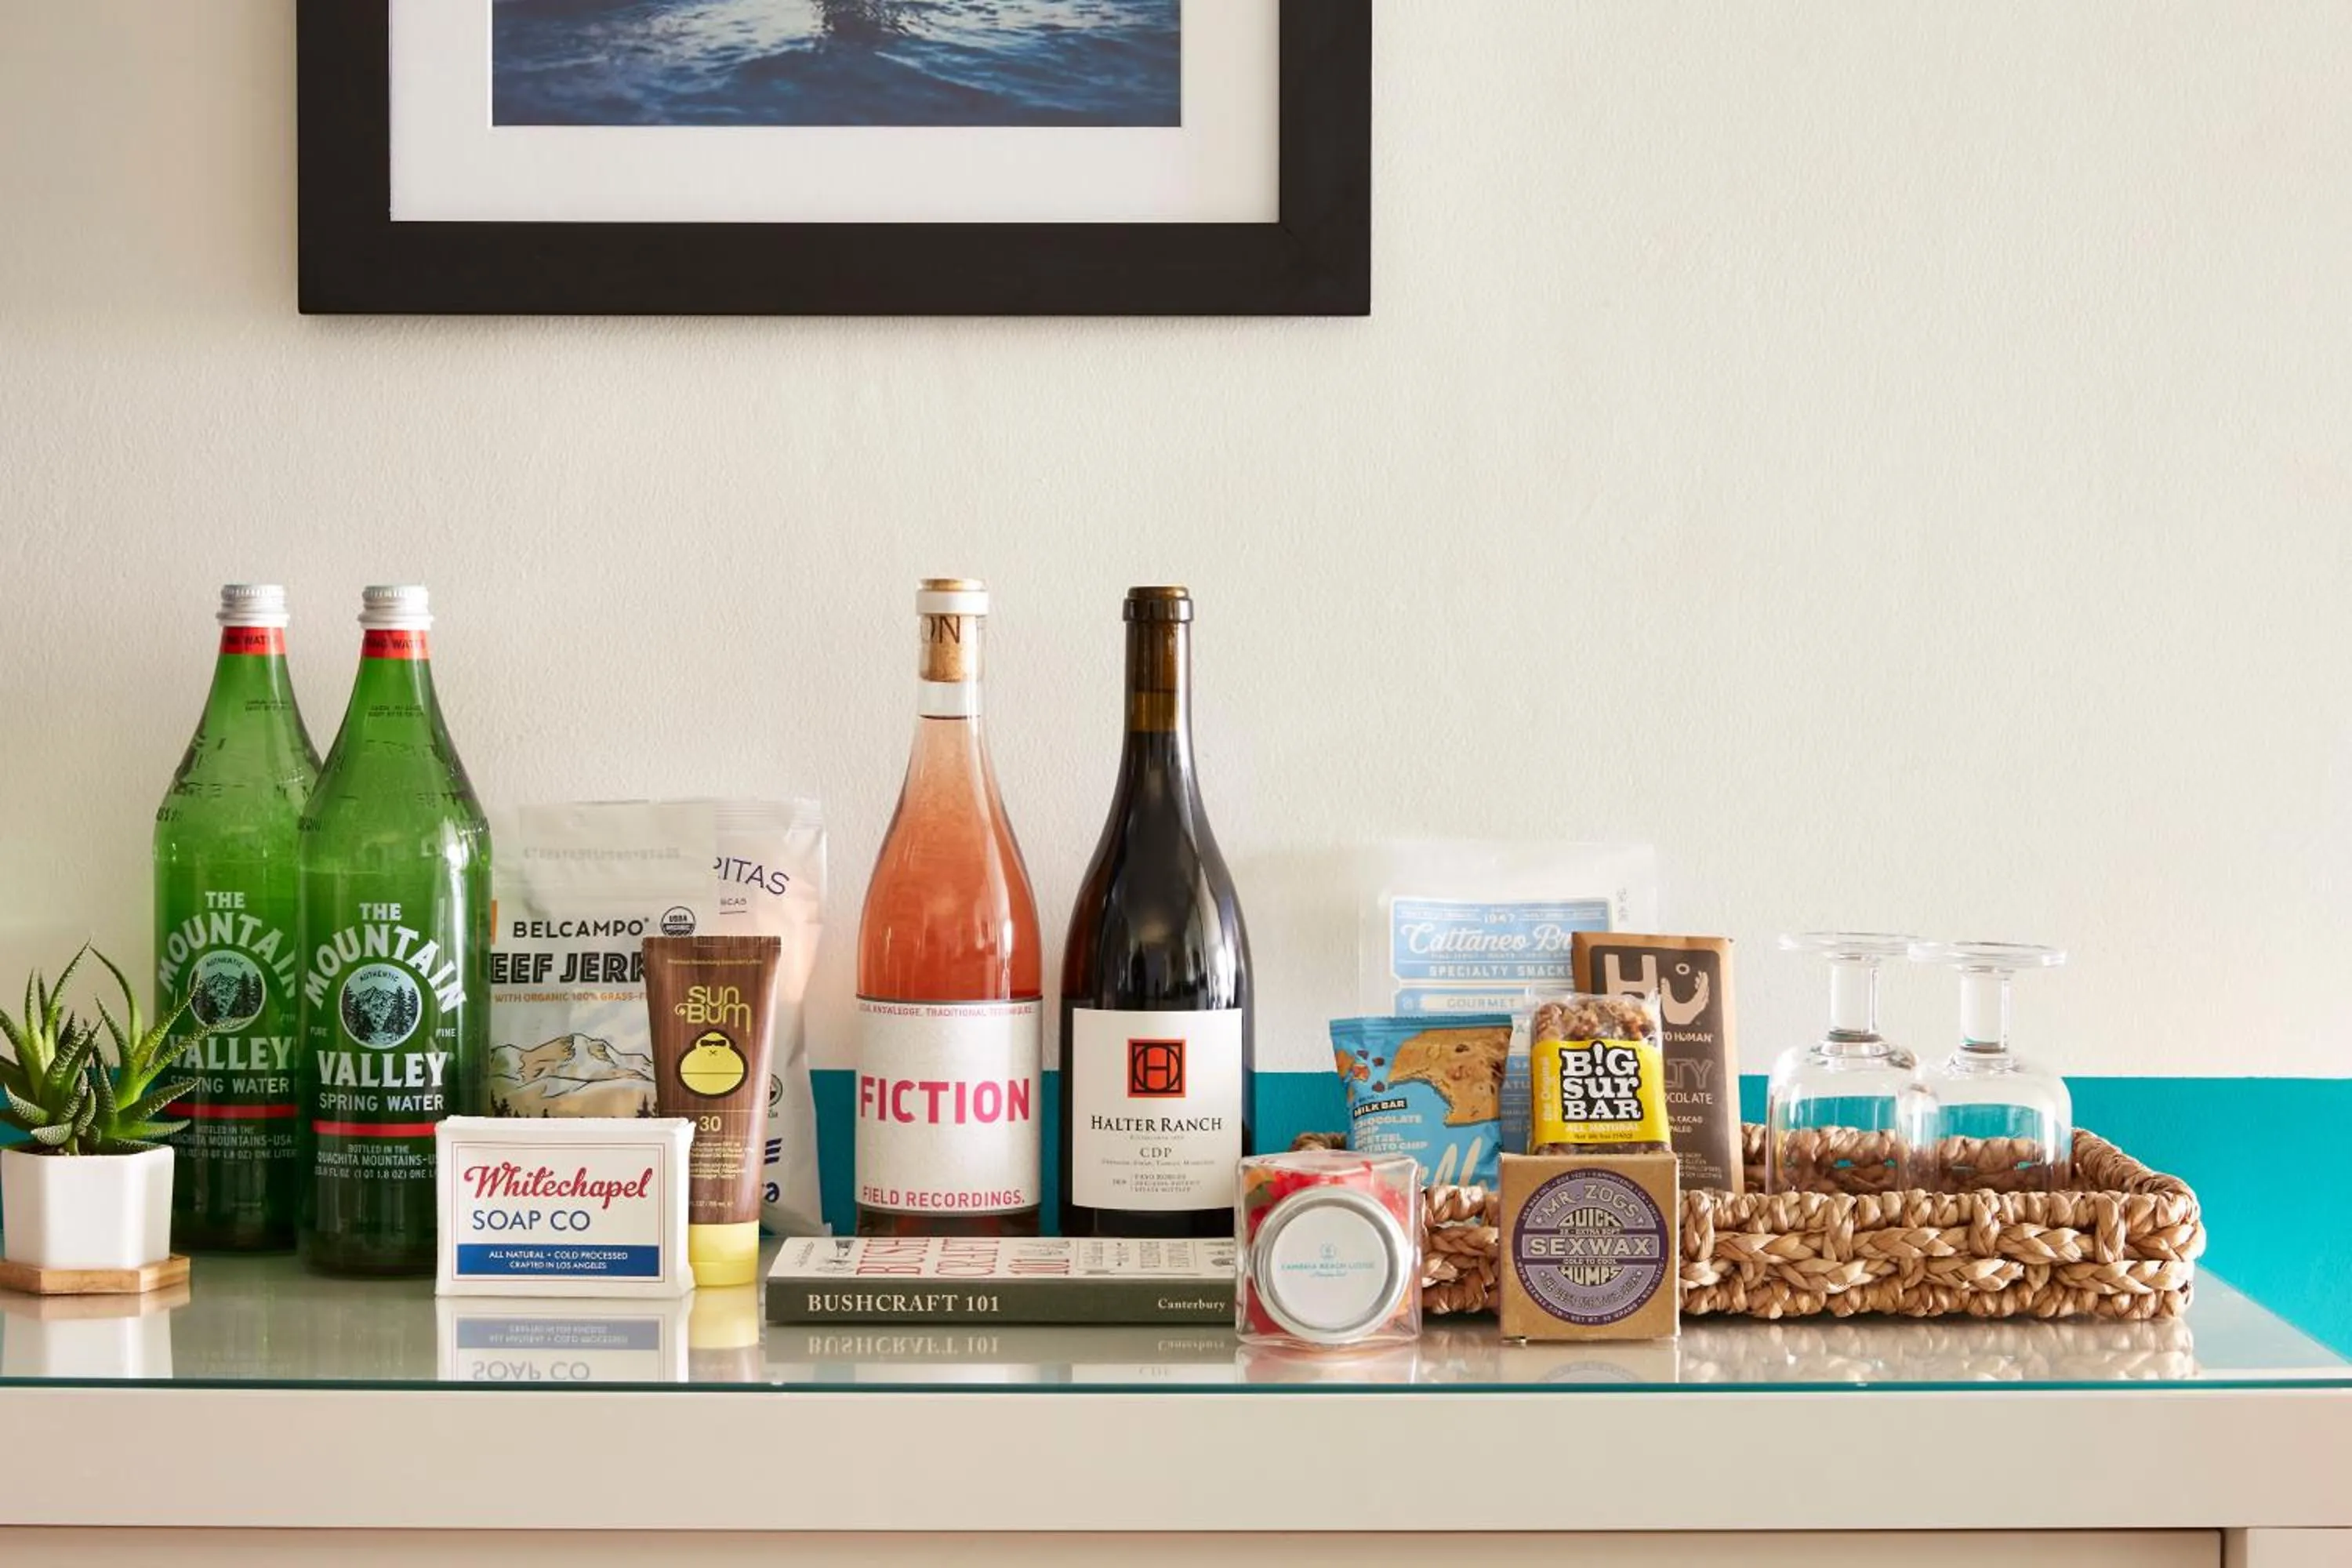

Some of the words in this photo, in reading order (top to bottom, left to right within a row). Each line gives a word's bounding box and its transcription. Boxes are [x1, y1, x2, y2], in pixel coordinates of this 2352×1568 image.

[205, 891, 245, 909] THE
[359, 903, 401, 920] THE
[513, 920, 644, 938] BELCAMPO
[1400, 921, 1527, 954] Cattaneo
[305, 924, 467, 1013] MOUNTAIN
[1428, 965, 1508, 977] SPECIALTY
[495, 993, 521, 1004] WITH
[523, 992, 569, 1004] ORGANIC
[1446, 997, 1515, 1009] GOURMET
[317, 1050, 448, 1087] VALLEY
[233, 1078, 289, 1094] WATER
[319, 1093, 378, 1111] SPRING
[387, 1094, 444, 1111] WATER
[860, 1075, 1030, 1124] FICTION
[1354, 1103, 1380, 1117] MILK
[1381, 1099, 1406, 1109] BAR
[1563, 1099, 1641, 1120] BAR
[699, 1116, 721, 1131] 30
[1091, 1115, 1156, 1132] HALTER
[1161, 1117, 1222, 1132] RANCH
[1139, 1147, 1173, 1158] CDP
[463, 1161, 653, 1210] Whitechapel
[863, 1186, 899, 1205] FIELD
[906, 1189, 1025, 1208] RECORDINGS.
[1541, 1190, 1581, 1218] MR.
[1584, 1184, 1639, 1217] ZOGS
[472, 1210, 541, 1230] SOAP
[550, 1210, 590, 1231] CO
[1558, 1207, 1623, 1227] QUICK
[1530, 1237, 1650, 1255] SEXWAX
[488, 1250, 504, 1259] ALL
[506, 1250, 544, 1260] NATURAL
[554, 1251, 579, 1260] COLD
[581, 1252, 627, 1261] PROCESSED
[556, 1261, 572, 1270] LOS
[573, 1261, 608, 1270] ANGELES
[808, 1294, 959, 1312] BUSHCRAFT
[966, 1294, 1000, 1312] 101
[1157, 1298, 1225, 1311] Canterbury
